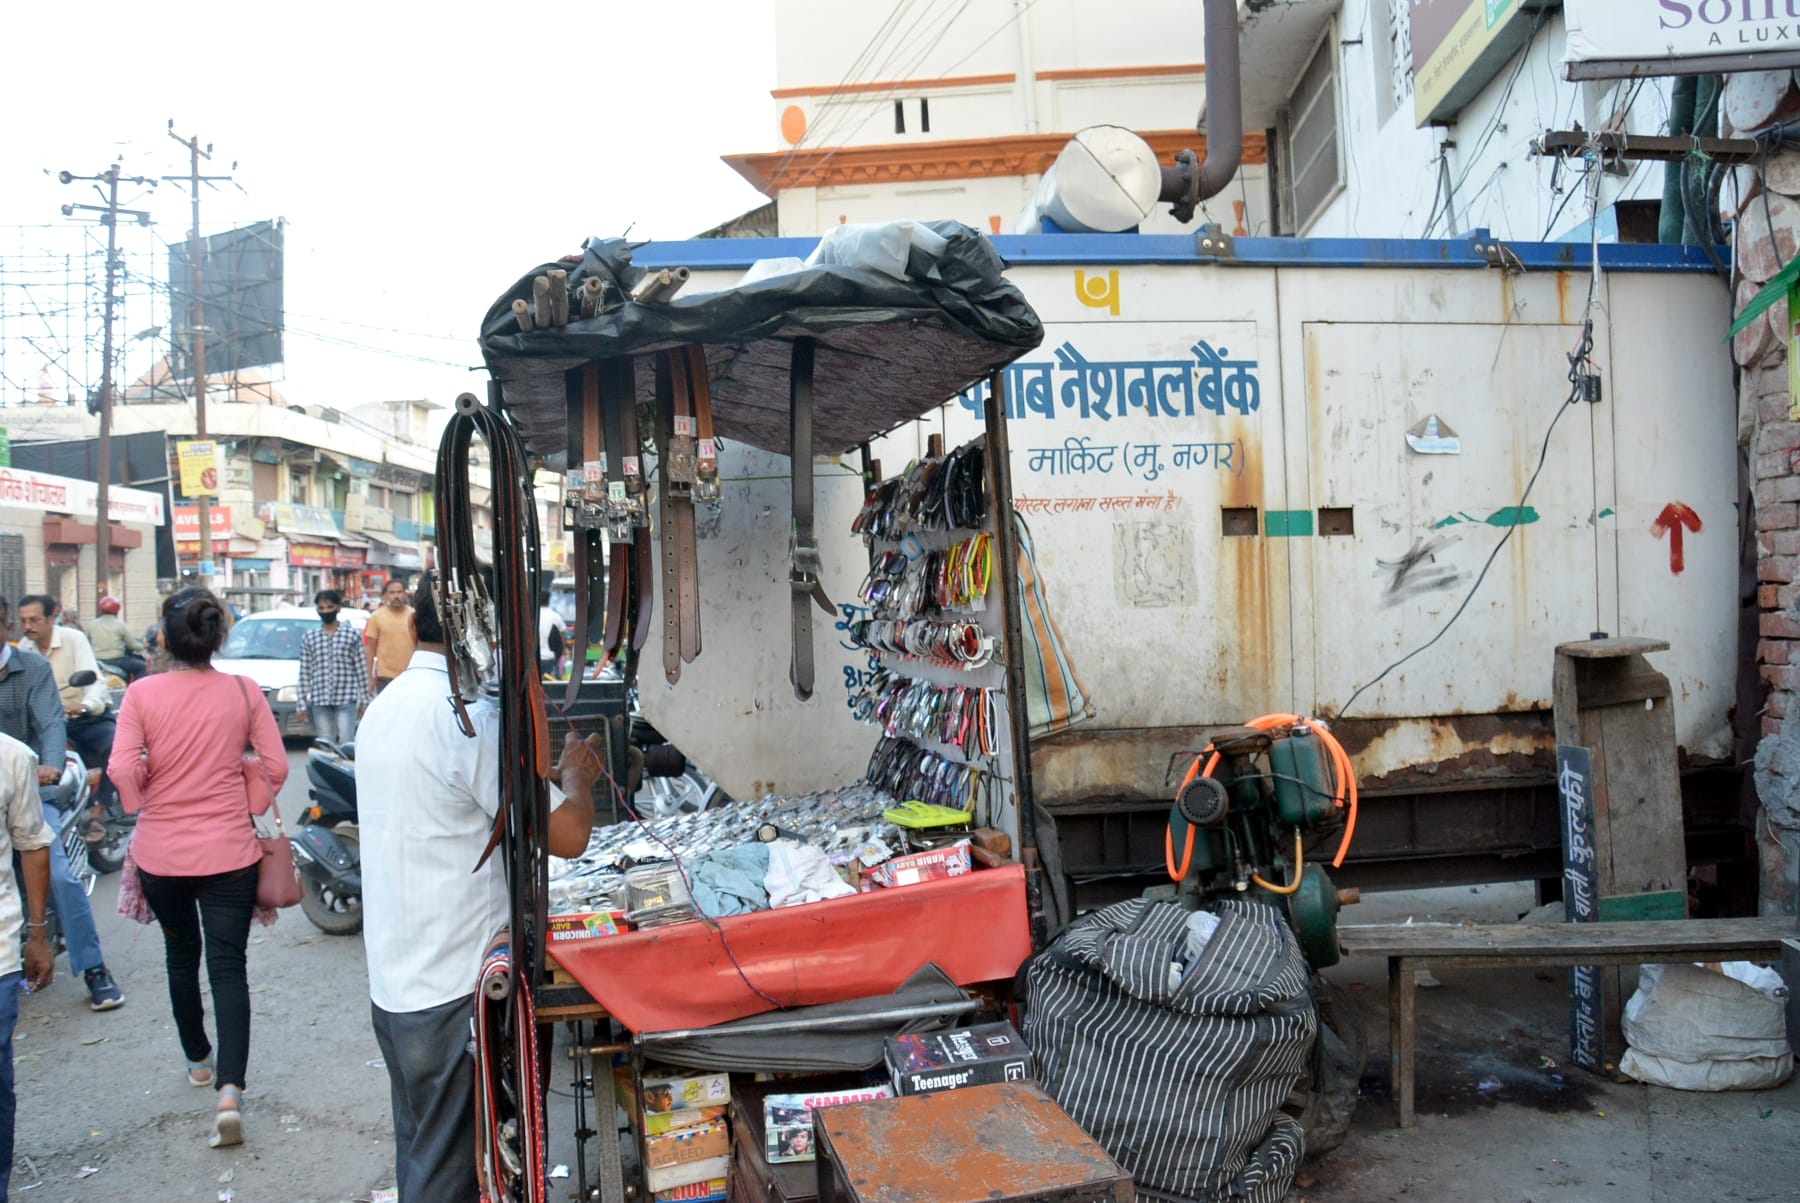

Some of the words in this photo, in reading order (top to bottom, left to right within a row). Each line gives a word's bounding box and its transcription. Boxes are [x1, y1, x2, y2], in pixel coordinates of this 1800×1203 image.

[1707, 31, 1723, 47] A
[1738, 24, 1800, 43] LUX
[1054, 341, 1195, 421] नैशनल
[1190, 339, 1261, 417] बैंक
[916, 853, 946, 866] KABIR
[551, 922, 571, 931] BABY
[552, 929, 591, 941] UNICORN
